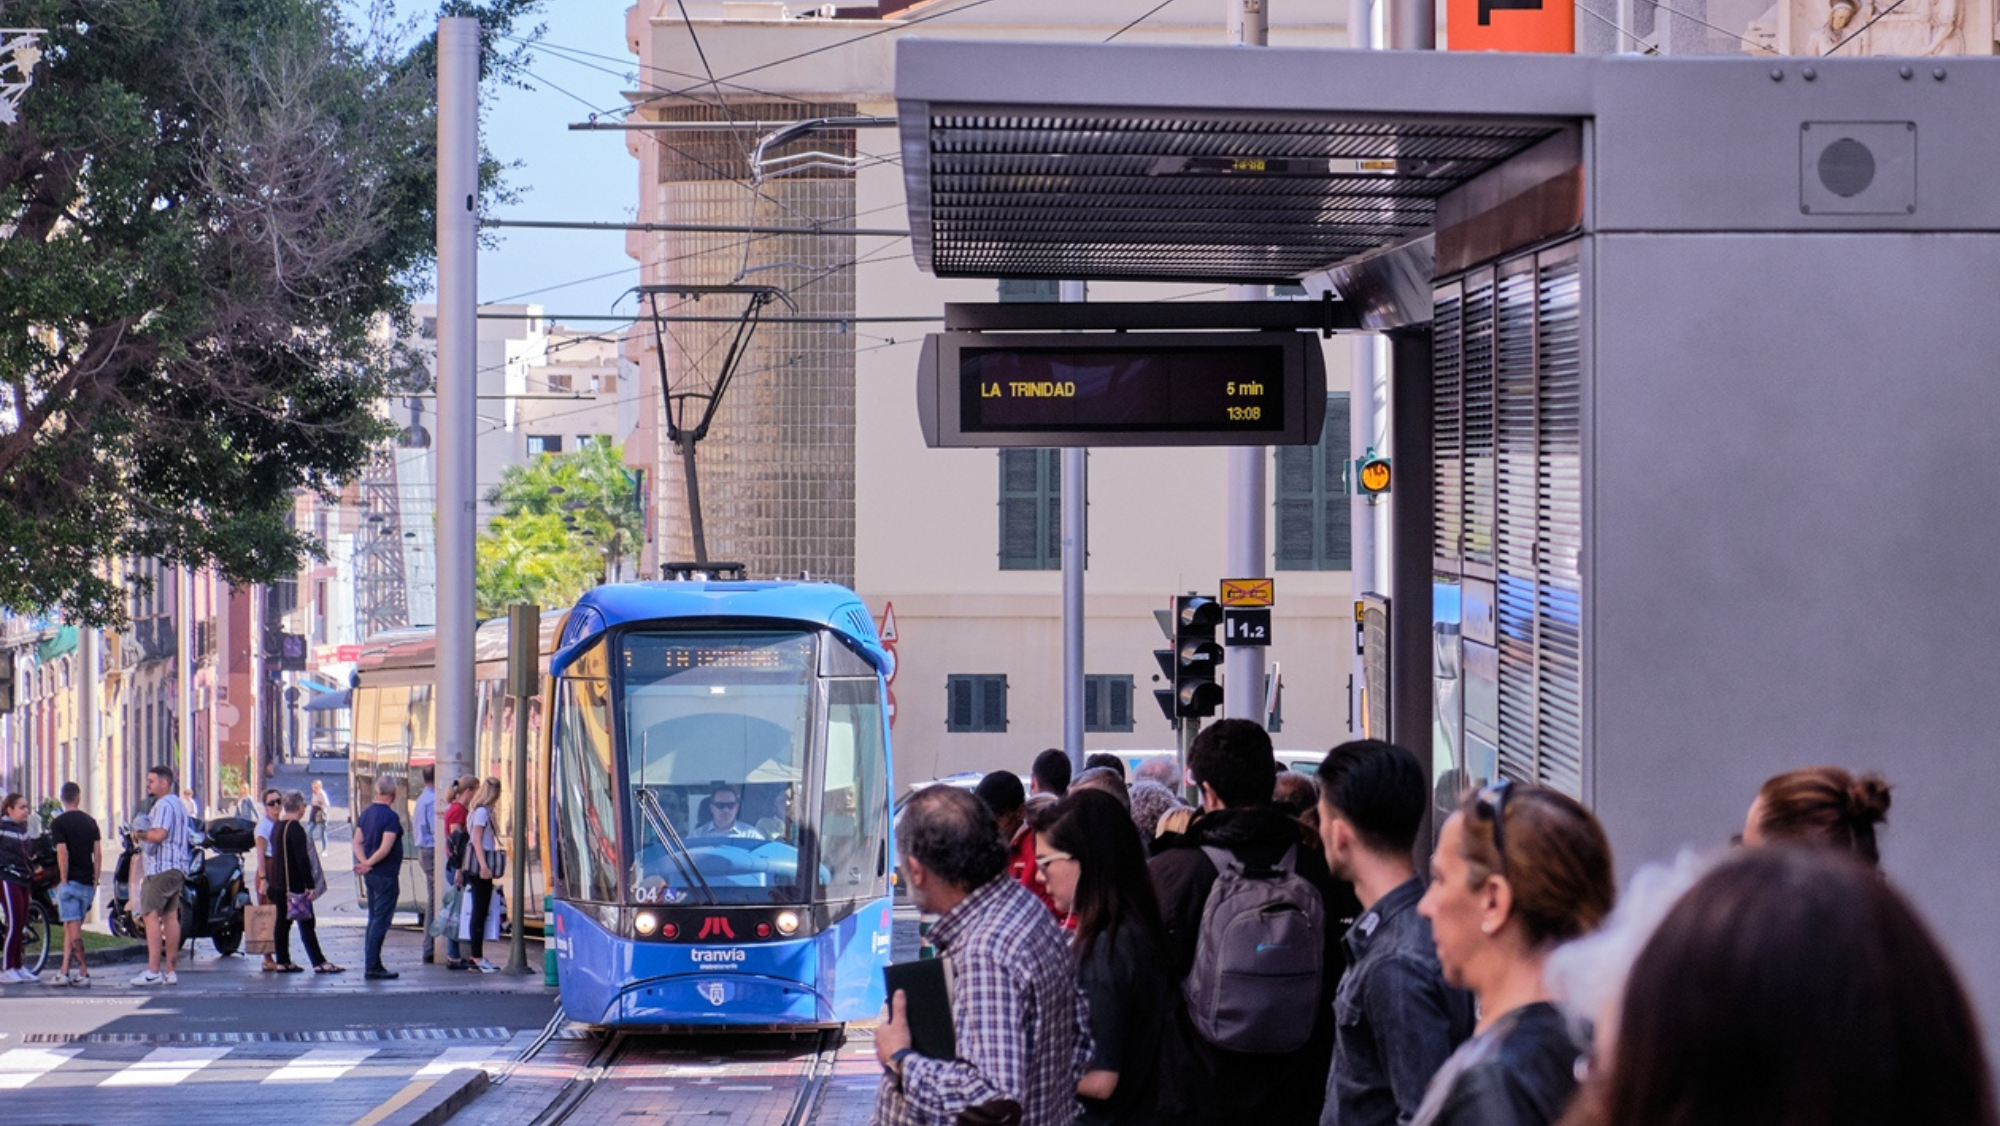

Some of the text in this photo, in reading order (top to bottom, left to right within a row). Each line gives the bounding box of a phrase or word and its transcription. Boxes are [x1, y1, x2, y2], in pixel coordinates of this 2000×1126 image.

[981, 382, 1075, 397] LA TRINIDAD
[1226, 380, 1264, 396] 5 min
[1227, 406, 1261, 420] 13:08
[635, 886, 657, 903] 04
